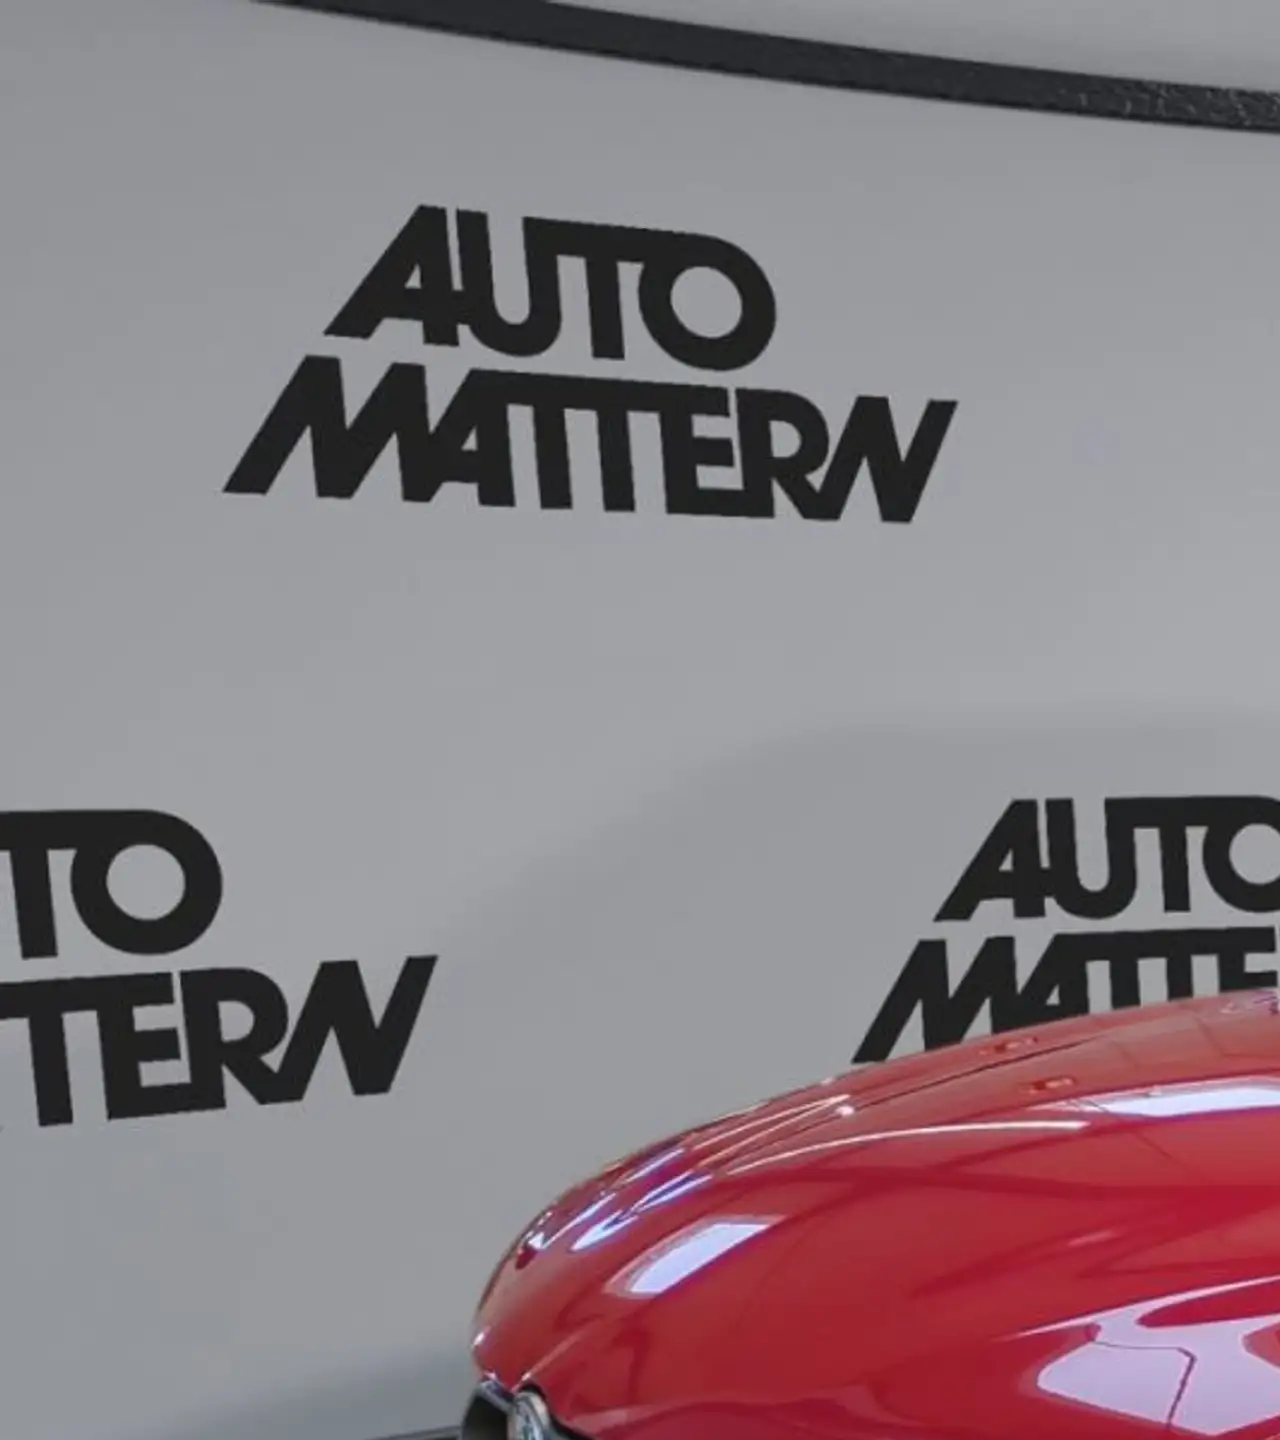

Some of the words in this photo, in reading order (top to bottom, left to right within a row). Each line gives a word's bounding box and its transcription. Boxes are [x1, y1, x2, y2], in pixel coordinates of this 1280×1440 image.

[323, 204, 777, 372] AUTO
[222, 354, 958, 524] MATTERN
[0, 809, 223, 960] TO
[0, 954, 438, 1128] TERN
